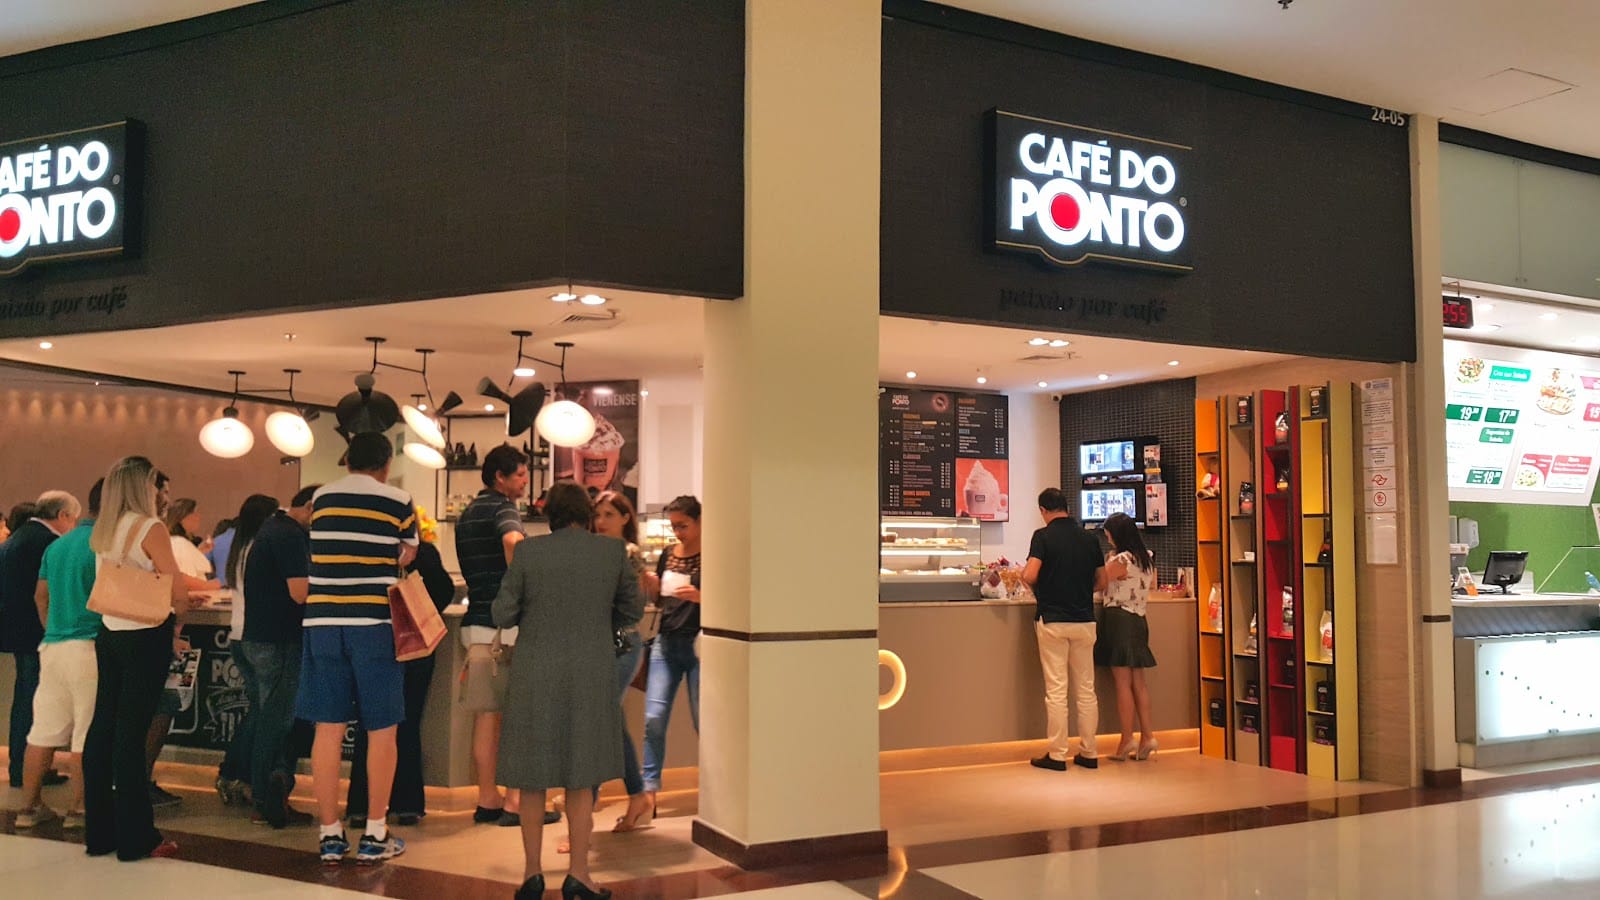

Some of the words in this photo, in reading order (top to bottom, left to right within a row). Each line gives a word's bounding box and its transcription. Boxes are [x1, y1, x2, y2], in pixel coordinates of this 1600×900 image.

[1371, 106, 1405, 126] 24-05
[57, 141, 109, 186] DO
[1019, 133, 1111, 185] CAFÉ
[1119, 149, 1175, 194] DO
[0, 187, 116, 257] ONTO
[1010, 177, 1185, 252] PONTO
[87, 286, 128, 314] café
